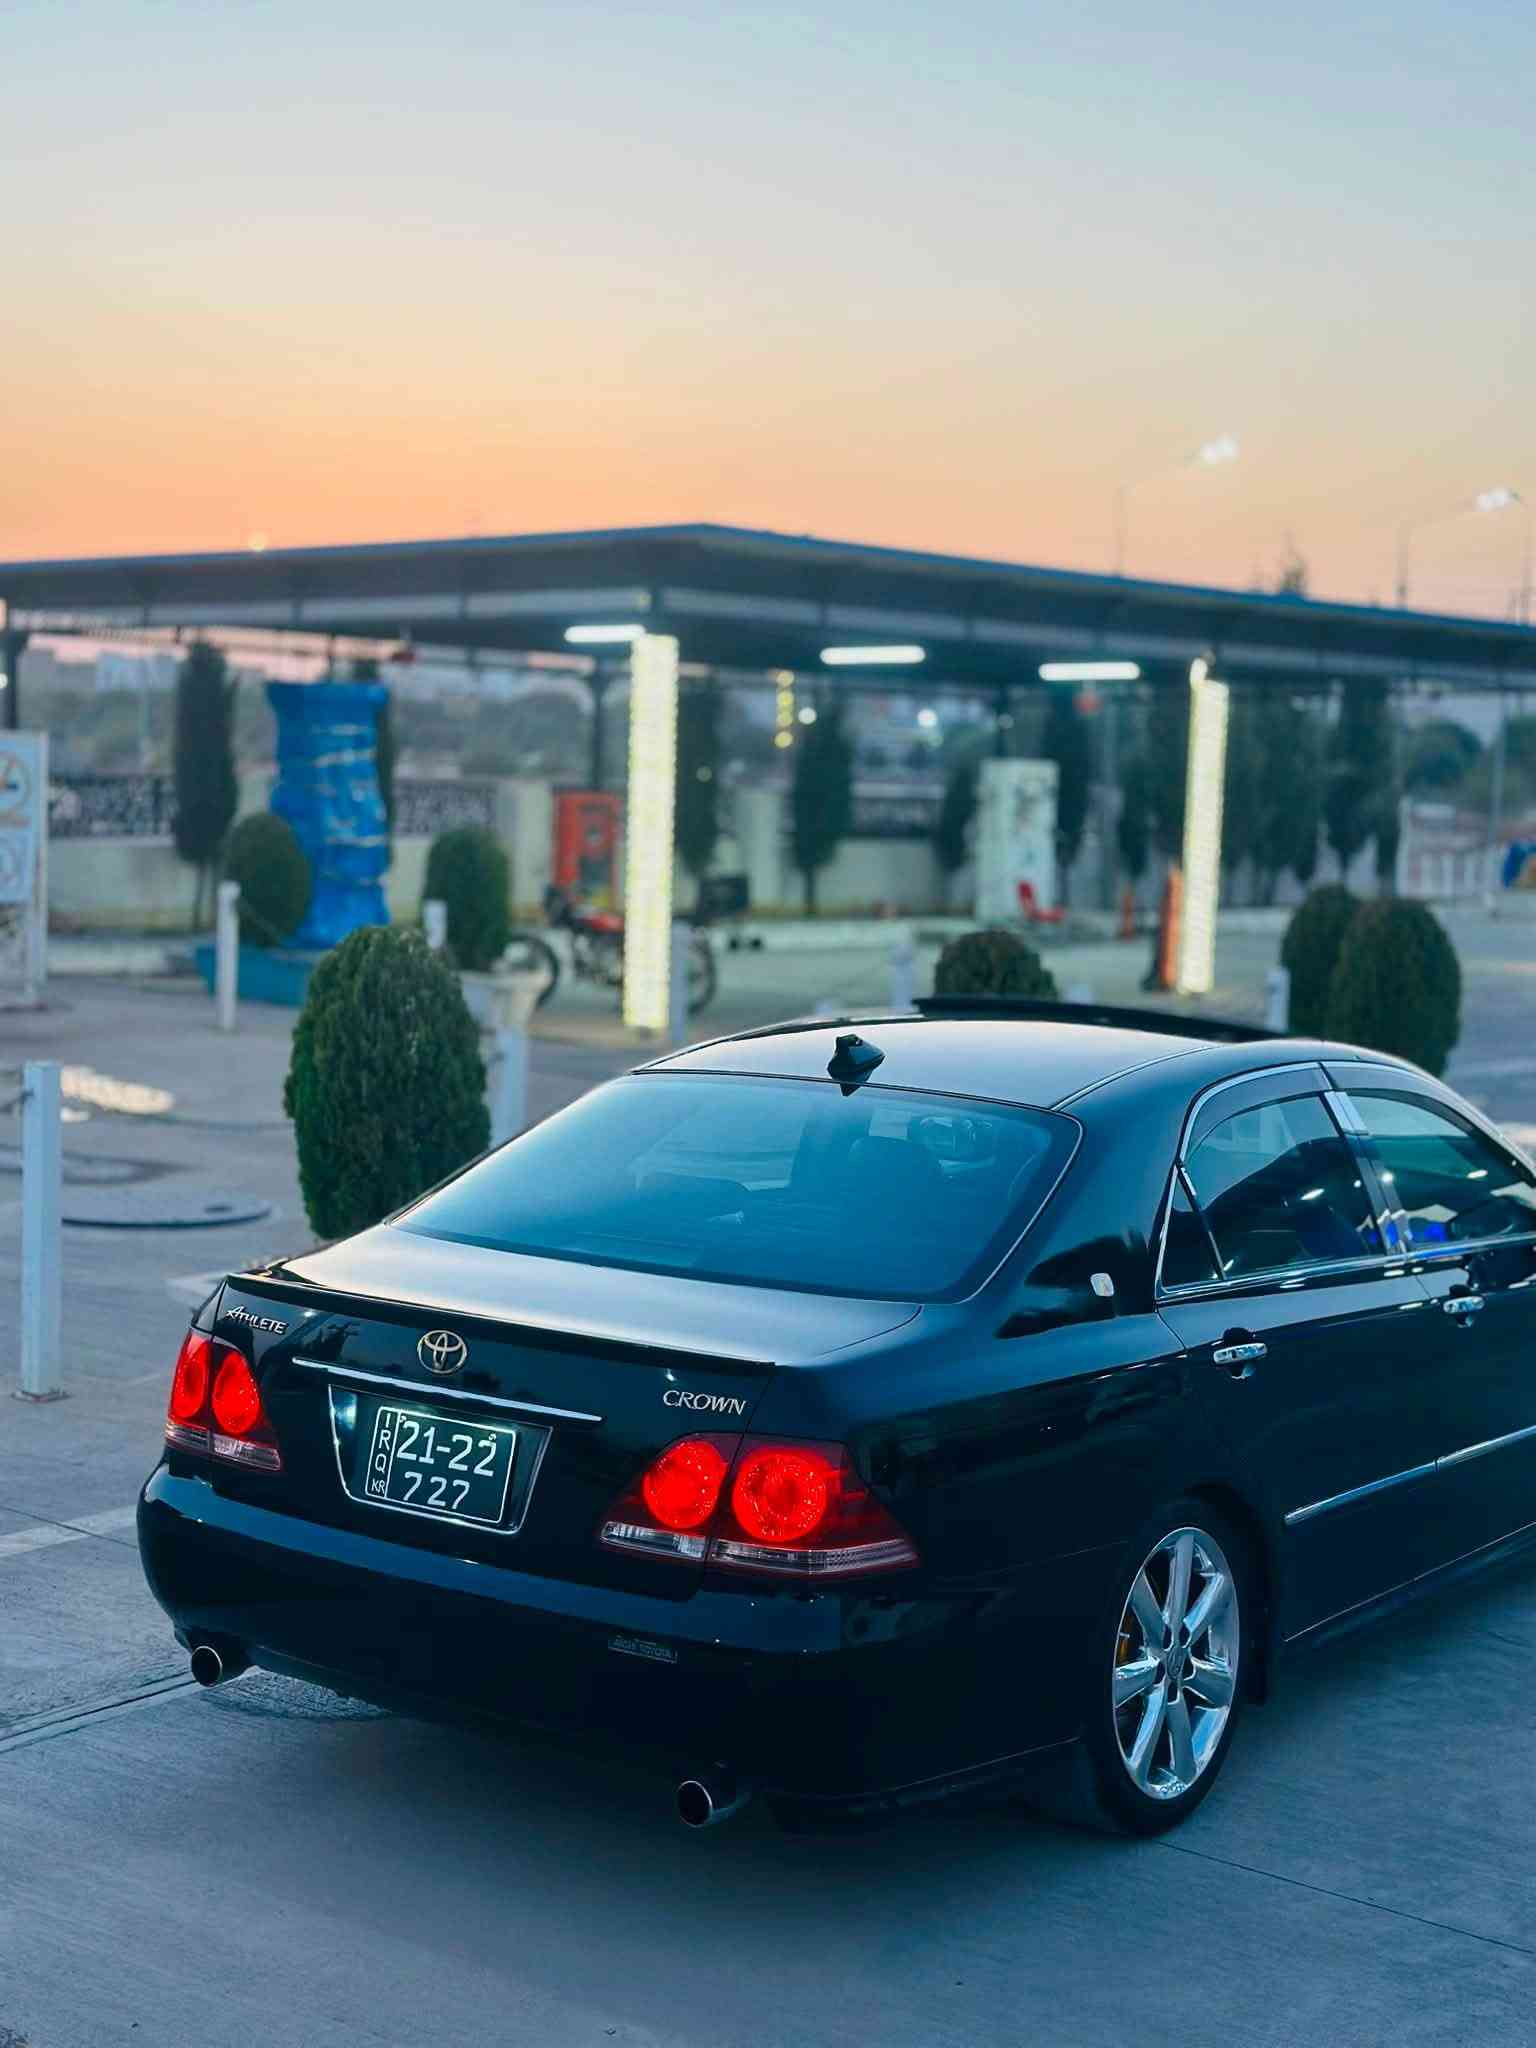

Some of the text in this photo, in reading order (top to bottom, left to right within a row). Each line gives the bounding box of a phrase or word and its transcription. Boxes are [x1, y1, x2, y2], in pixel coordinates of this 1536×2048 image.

[663, 1389, 746, 1415] CROWN
[396, 1420, 497, 1477] 21-22
[403, 1471, 471, 1510] 727
